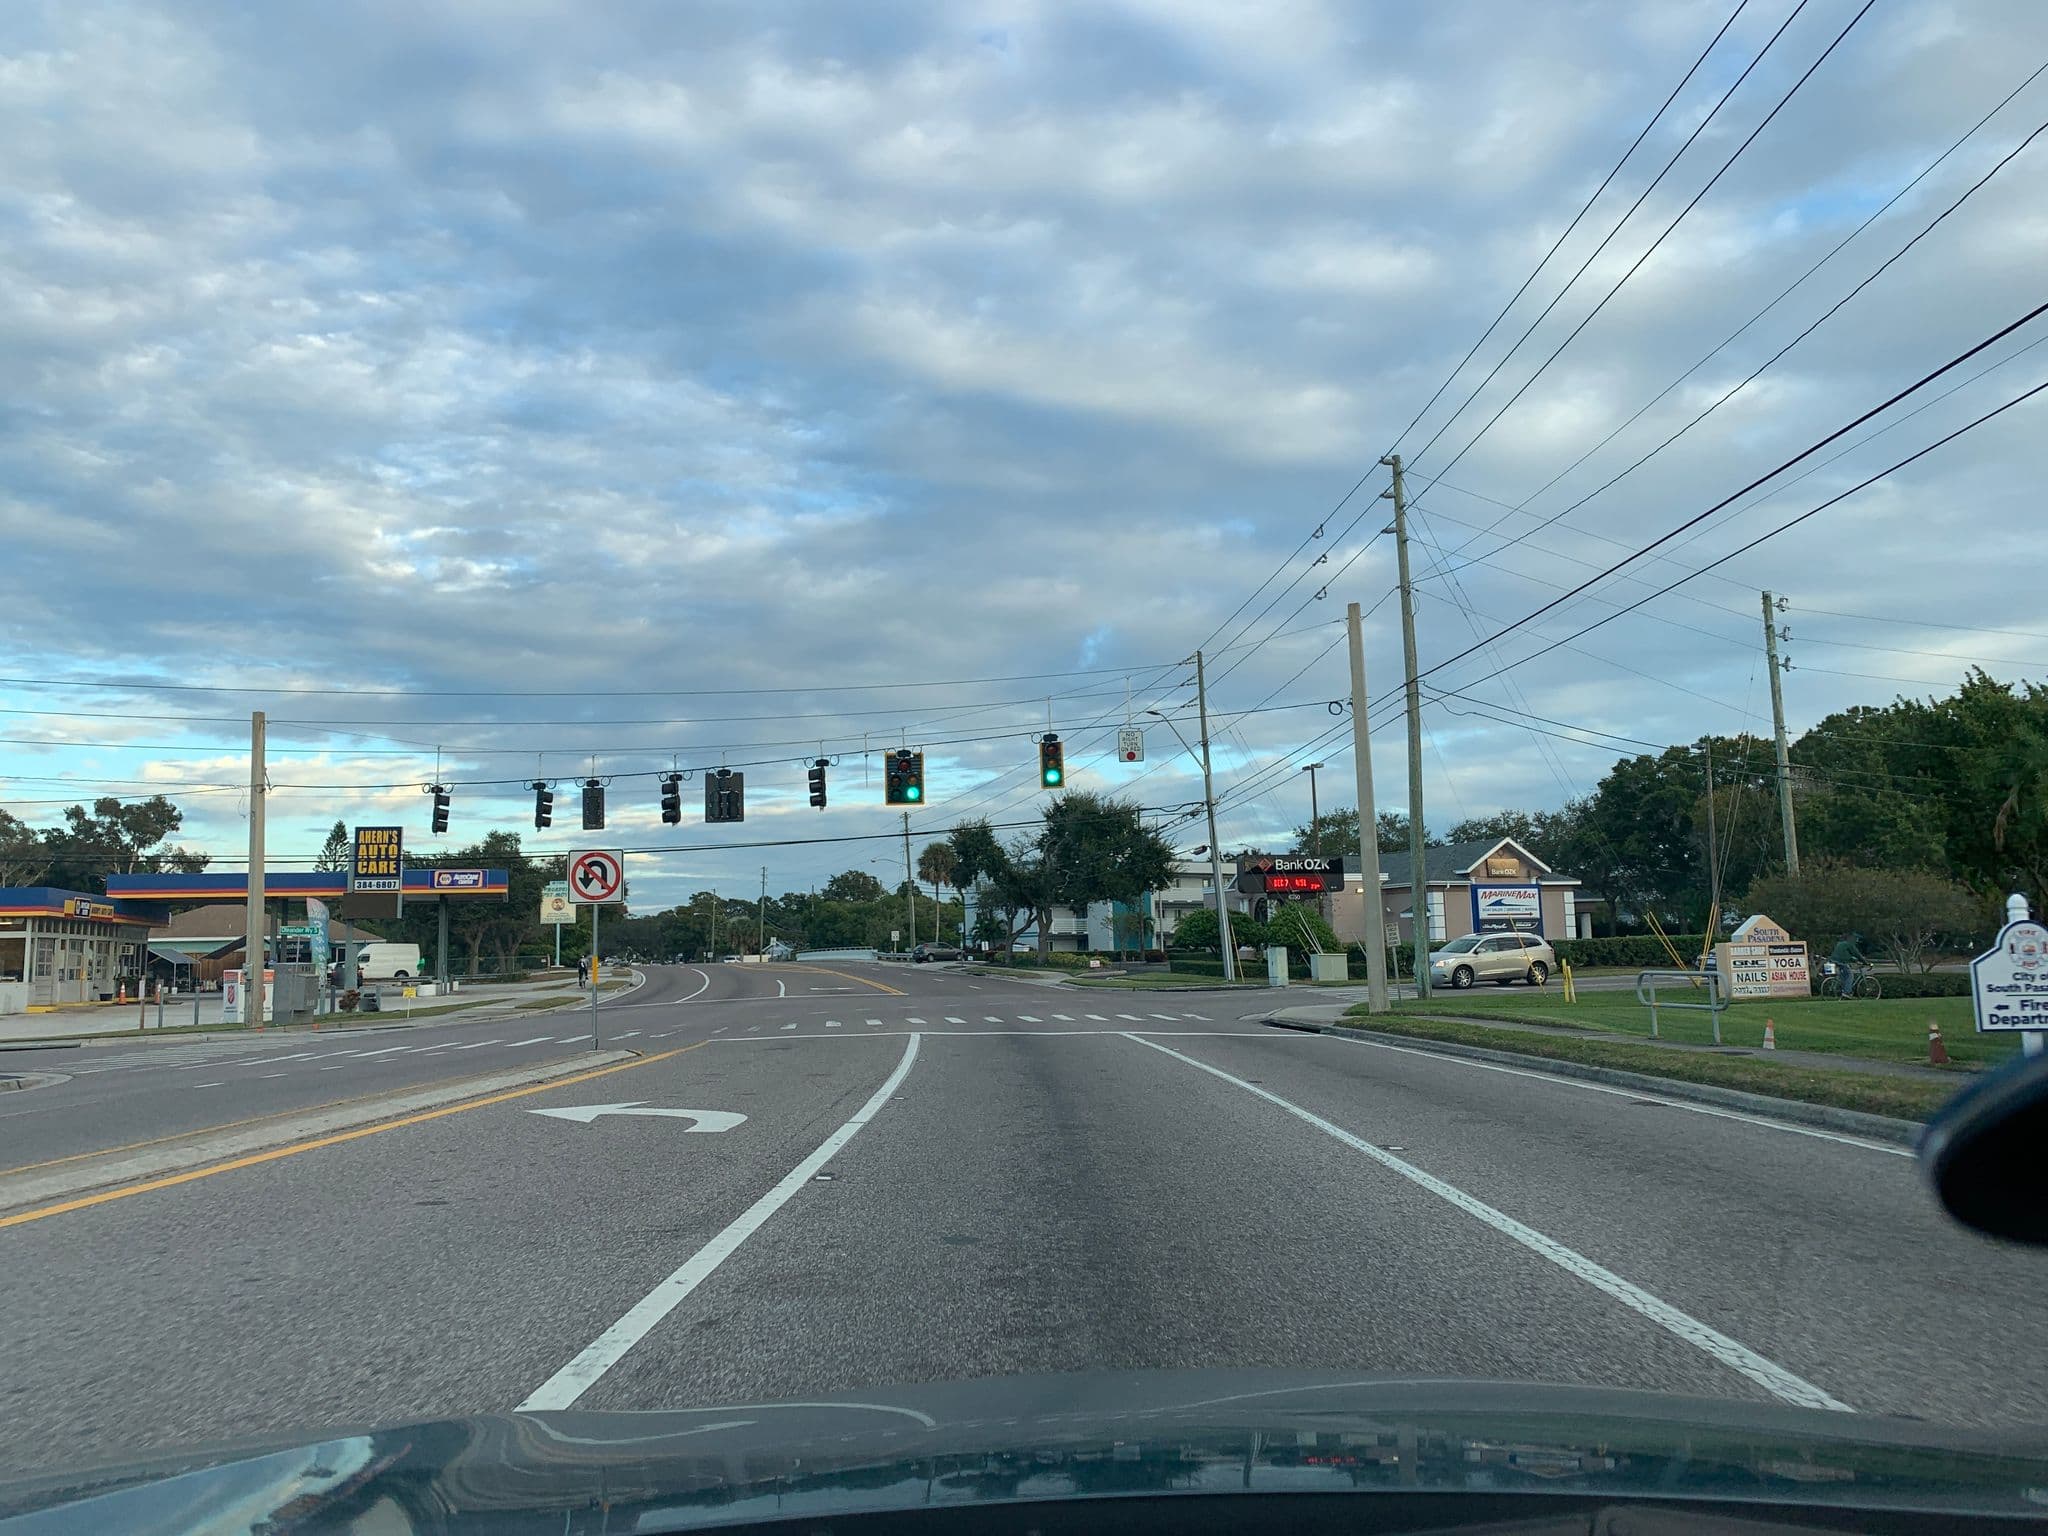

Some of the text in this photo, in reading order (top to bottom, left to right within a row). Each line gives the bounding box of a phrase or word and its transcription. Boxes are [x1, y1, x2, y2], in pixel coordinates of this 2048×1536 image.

[358, 830, 398, 844] AHERN'S
[358, 844, 398, 858] AUTO
[358, 861, 397, 874] CARE
[1275, 859, 1330, 870] Bank OZK
[356, 881, 397, 889] 384-6807
[1754, 928, 1778, 936] SOUTH
[1774, 958, 1802, 968] YOGA
[1736, 972, 1768, 982] NAILS
[1772, 971, 1806, 980] ASIAN HOUSE
[2012, 972, 2035, 982] City
[1987, 984, 2021, 992] South
[2020, 999, 2048, 1010] Fire
